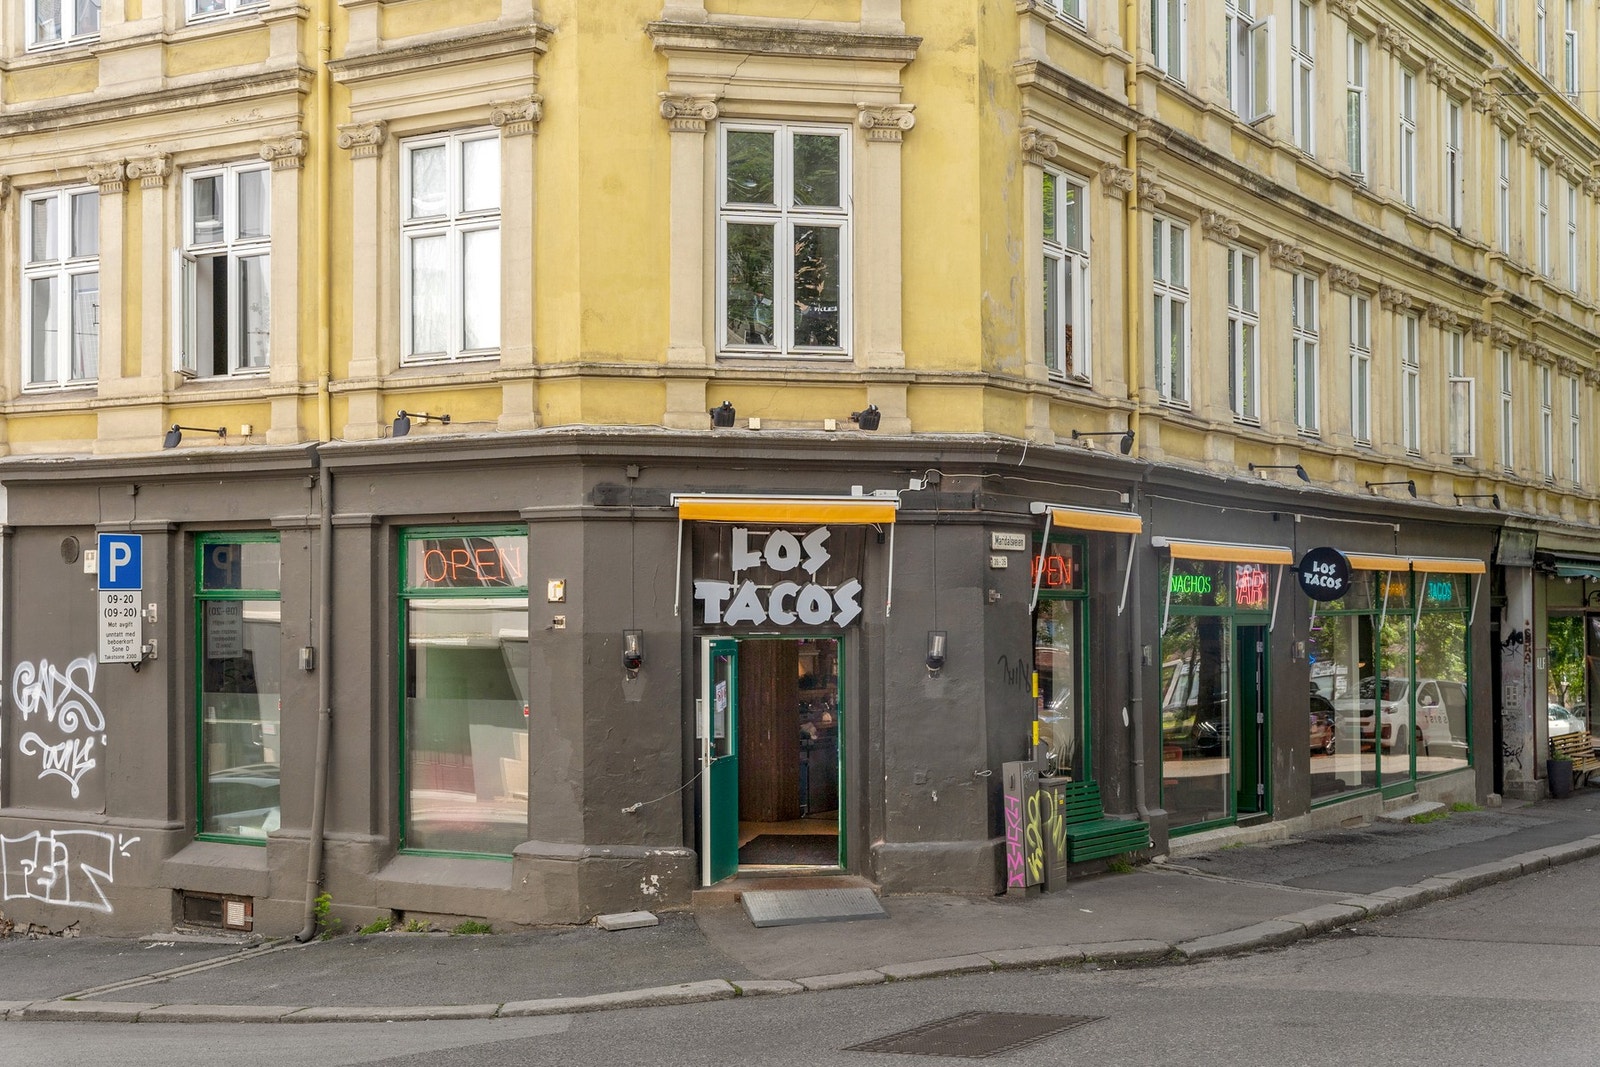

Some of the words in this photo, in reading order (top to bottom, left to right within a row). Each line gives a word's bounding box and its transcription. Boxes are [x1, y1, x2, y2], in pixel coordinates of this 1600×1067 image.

[732, 526, 831, 575] LOS
[109, 541, 132, 582] P
[423, 547, 522, 582] OPEN
[1031, 556, 1072, 585] PEN
[1312, 561, 1336, 576] LOS
[1170, 574, 1212, 593] NACHOS
[1304, 572, 1343, 590] TACOS
[107, 594, 134, 604] 09-20
[694, 577, 862, 628] TACOS
[103, 607, 137, 618] (09-20)
[119, 621, 133, 629] avgift
[111, 645, 123, 653] Sone
